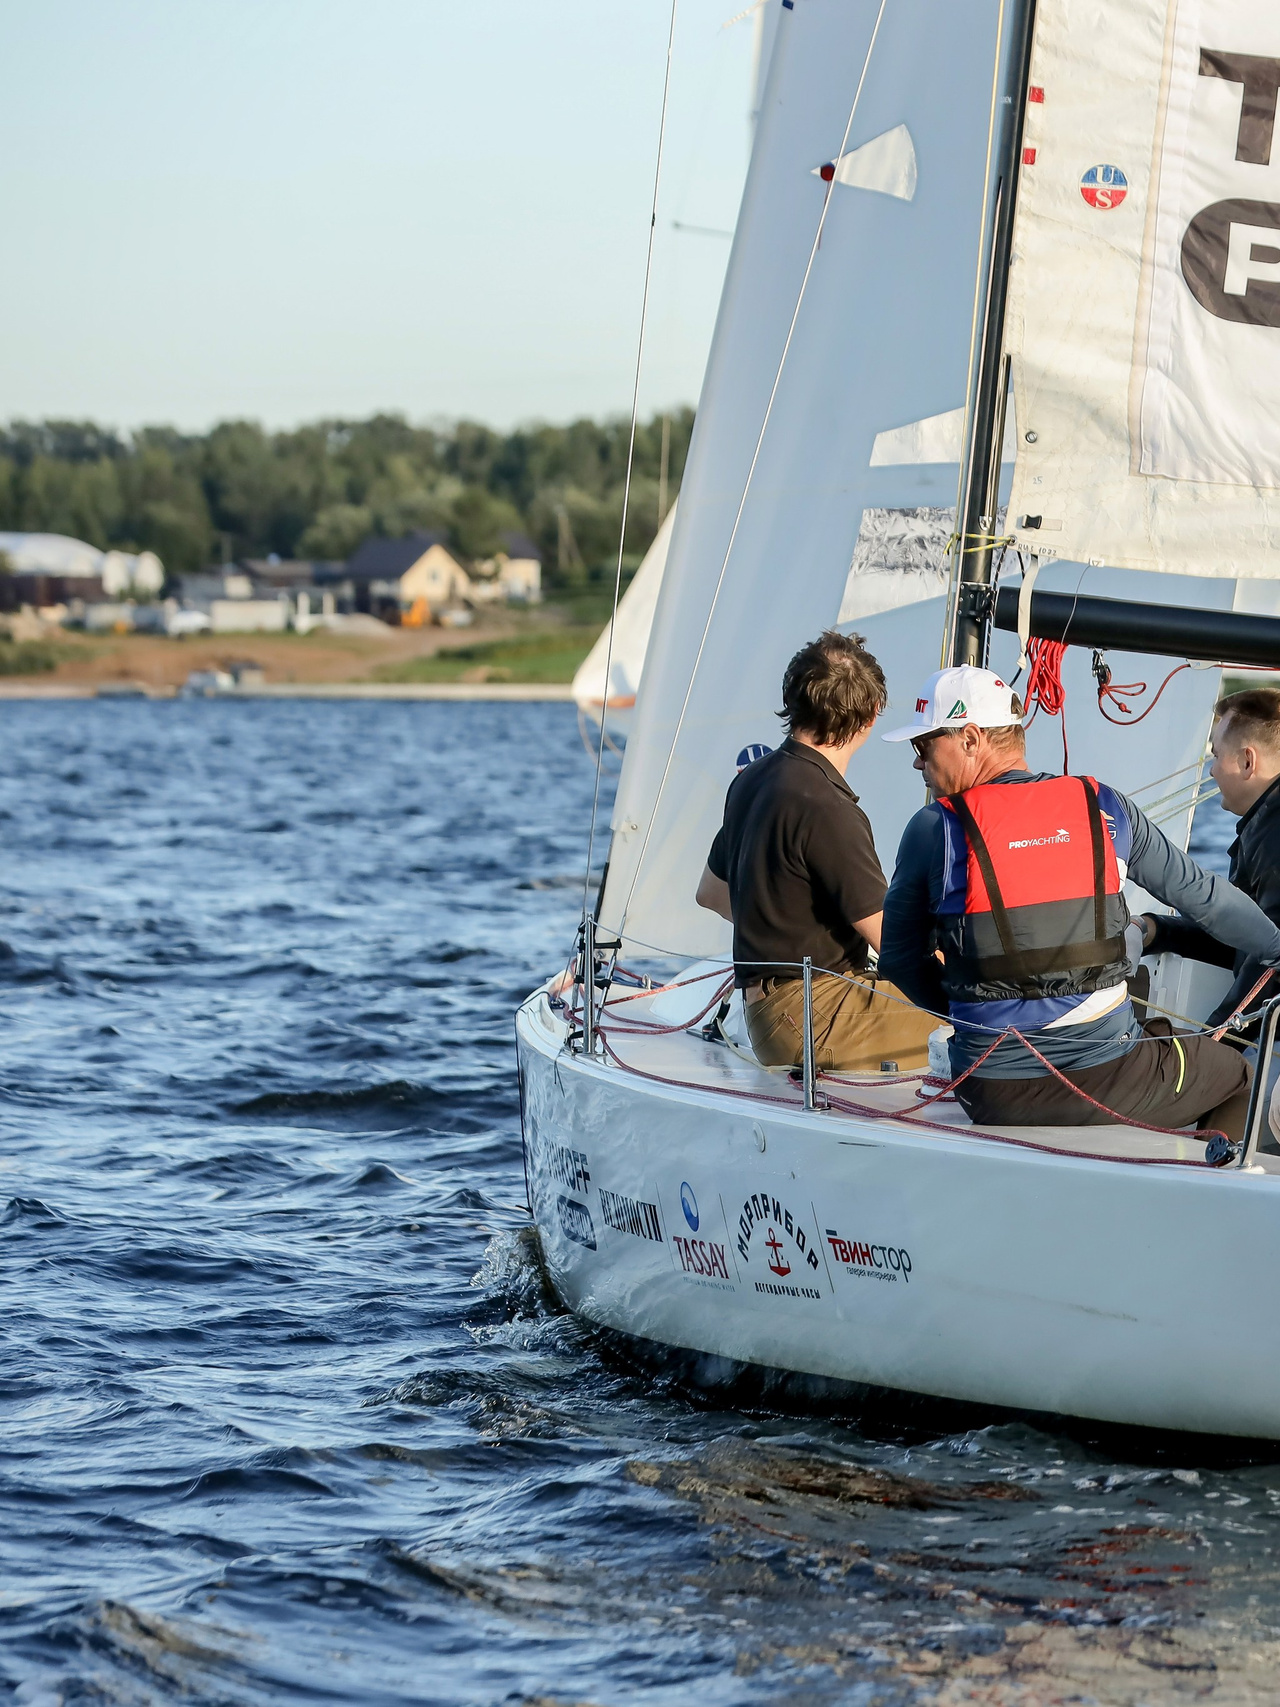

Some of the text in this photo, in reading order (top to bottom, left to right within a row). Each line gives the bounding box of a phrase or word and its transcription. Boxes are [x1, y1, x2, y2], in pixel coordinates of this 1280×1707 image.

[1008, 834, 1071, 850] PROYACHTING
[737, 1192, 820, 1271] МОРПРИБОР
[673, 1236, 730, 1280] TASSAY
